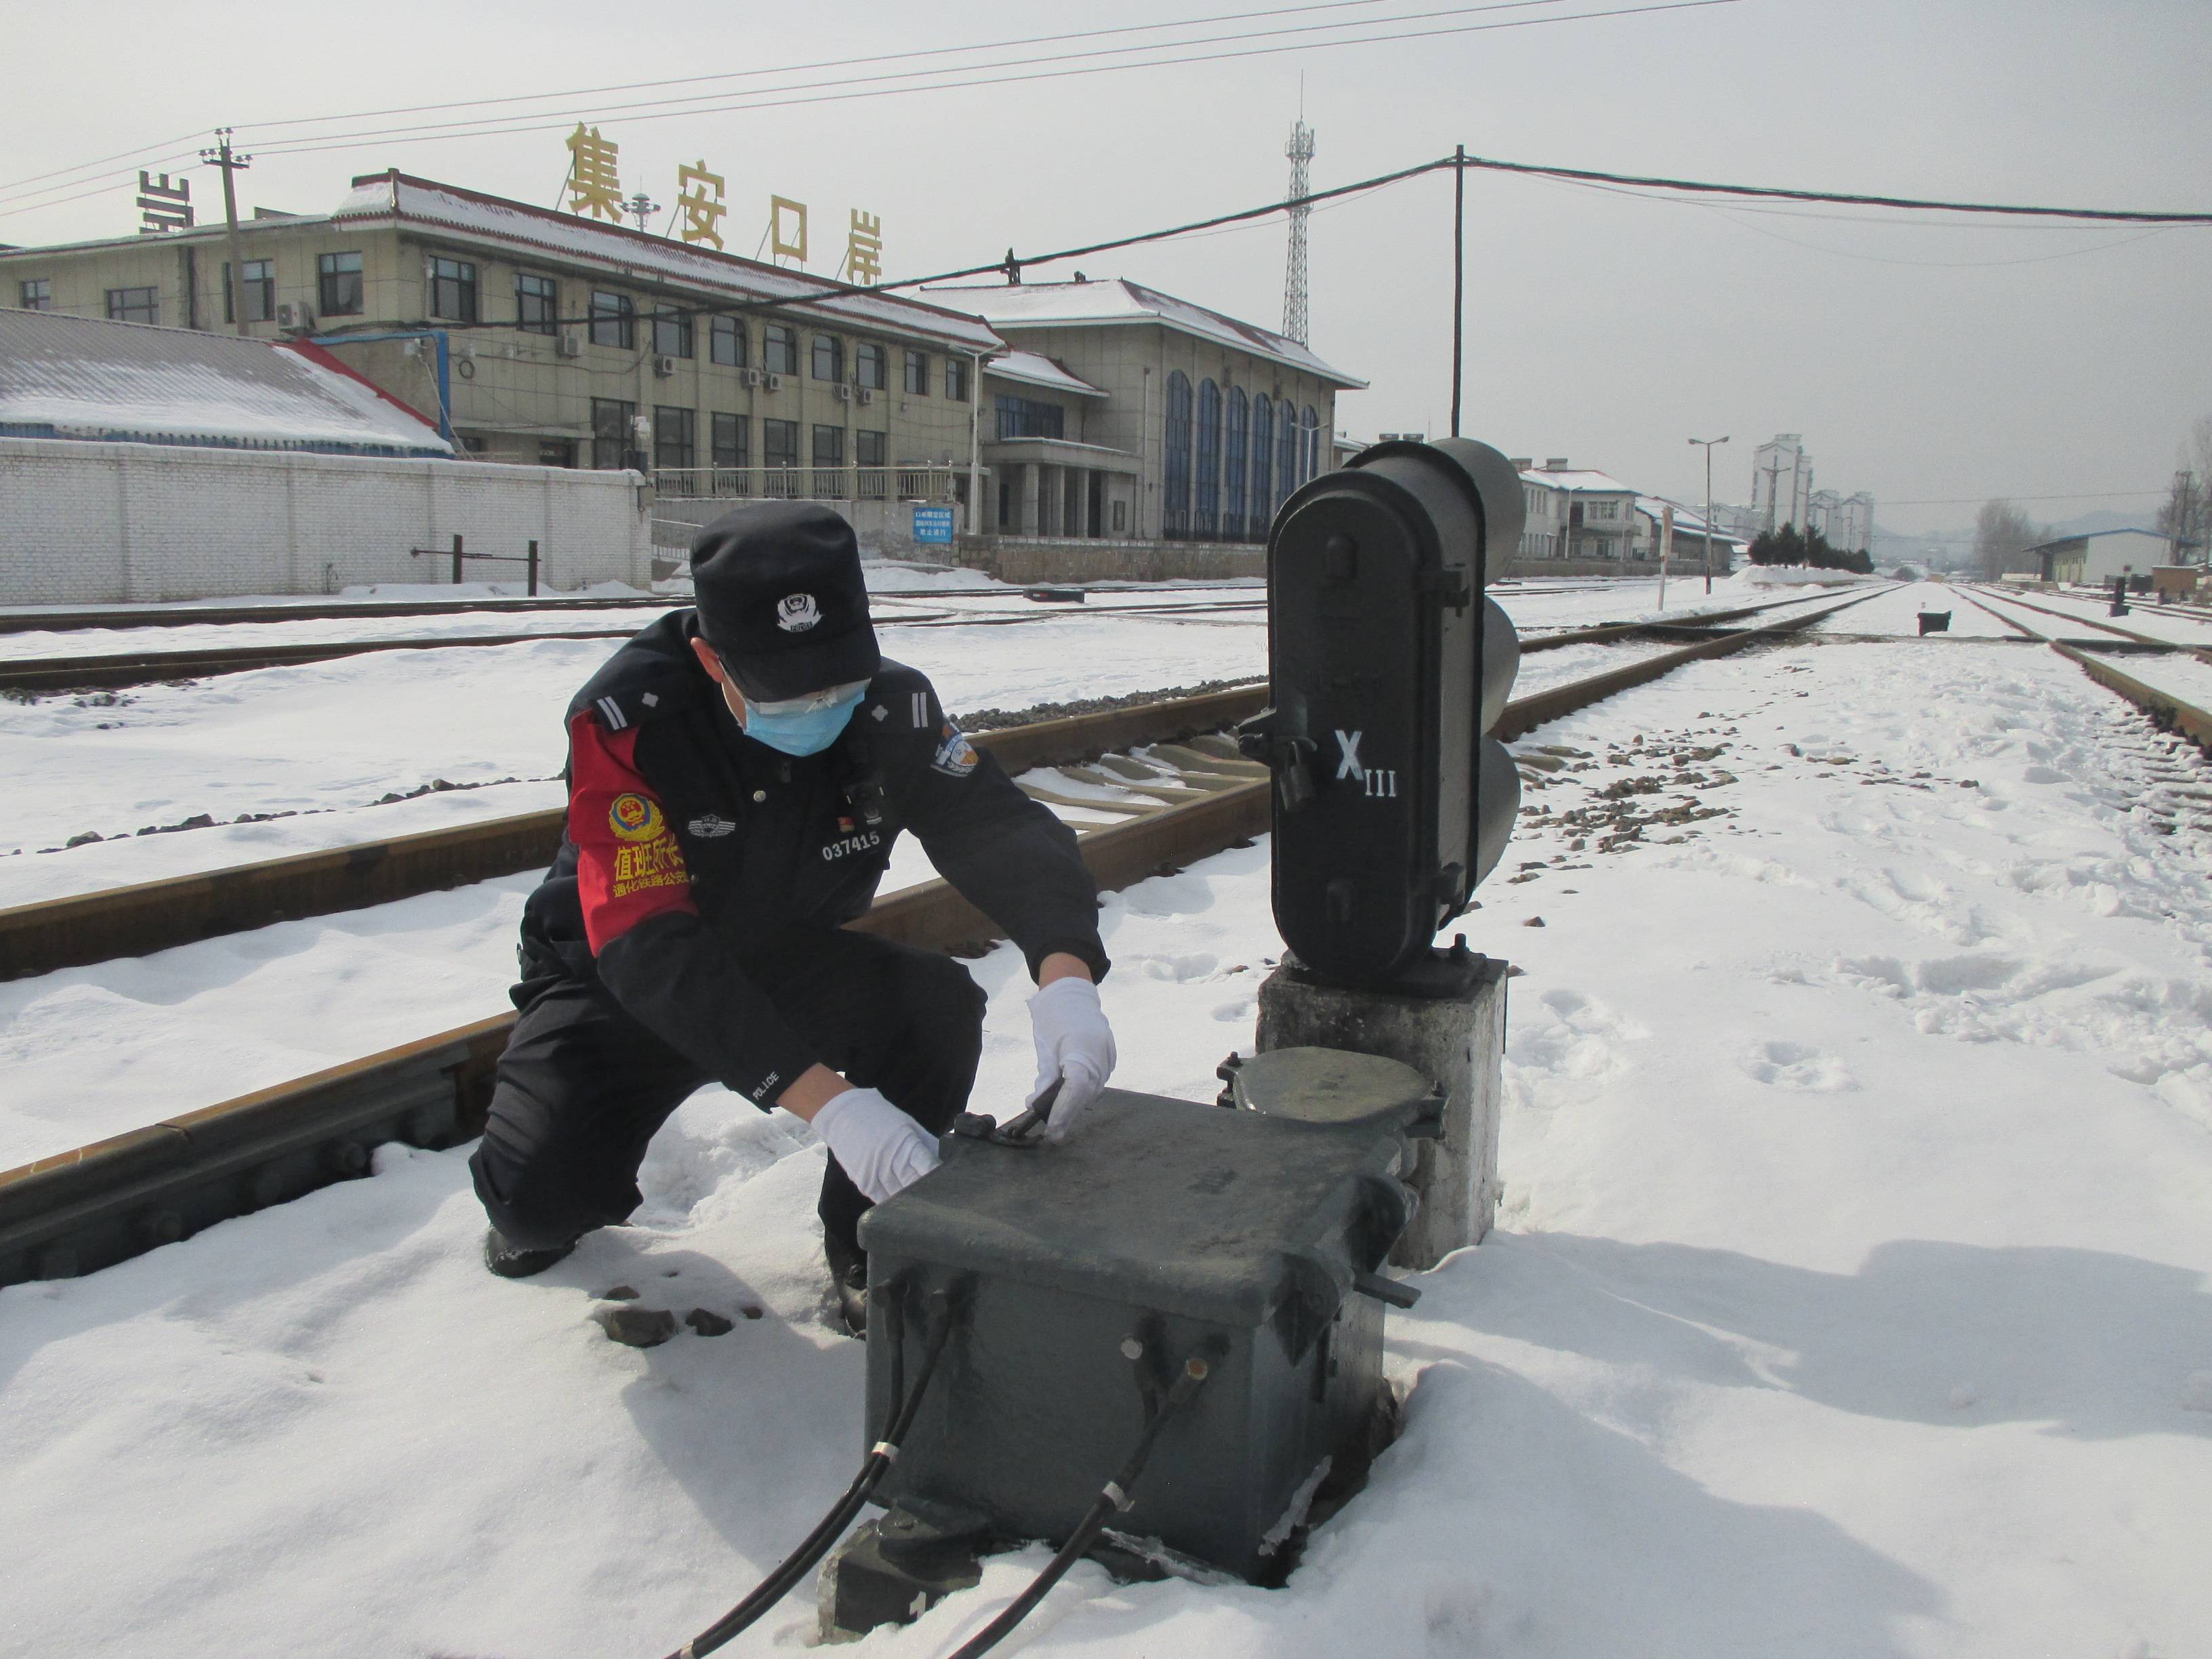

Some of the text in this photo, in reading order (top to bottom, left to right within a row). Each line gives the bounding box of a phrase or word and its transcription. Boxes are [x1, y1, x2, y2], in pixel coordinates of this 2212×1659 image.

[565, 121, 883, 285] 集安口岸
[614, 833, 684, 882] 值班所长
[822, 831, 880, 861] 037415
[752, 1071, 779, 1101] POLICE
